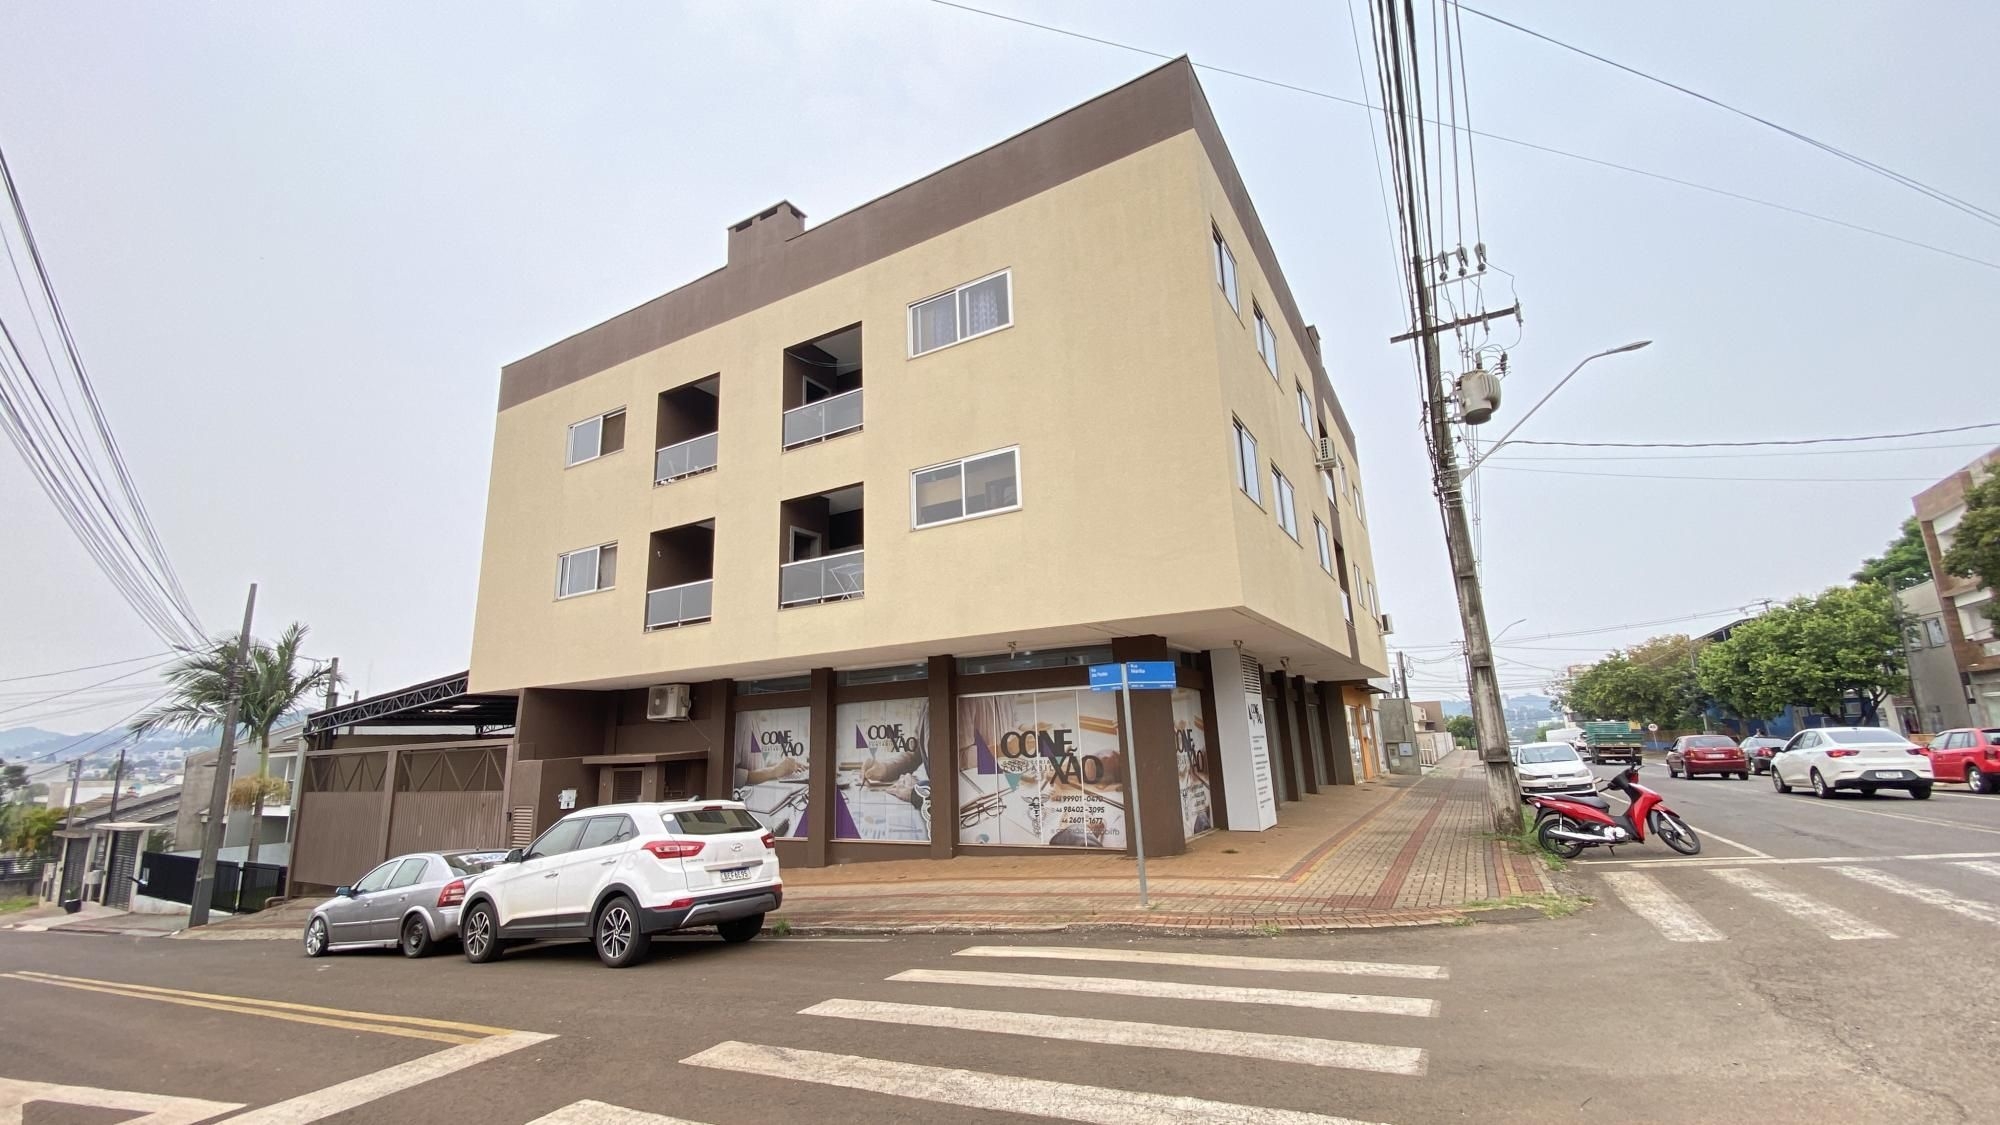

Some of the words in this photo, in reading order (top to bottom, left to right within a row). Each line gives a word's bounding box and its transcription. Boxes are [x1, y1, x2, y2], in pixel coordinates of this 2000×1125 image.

[761, 730, 792, 745] CONE
[868, 724, 903, 740] CONE
[1176, 729, 1193, 752] ONE
[781, 740, 804, 757] XÃO
[891, 734, 918, 753] XÃO
[1001, 729, 1072, 758] CONE
[1050, 747, 1104, 784] XÃO
[1063, 806, 1105, 814] 98402-3095
[1069, 816, 1103, 824] 2601-1677
